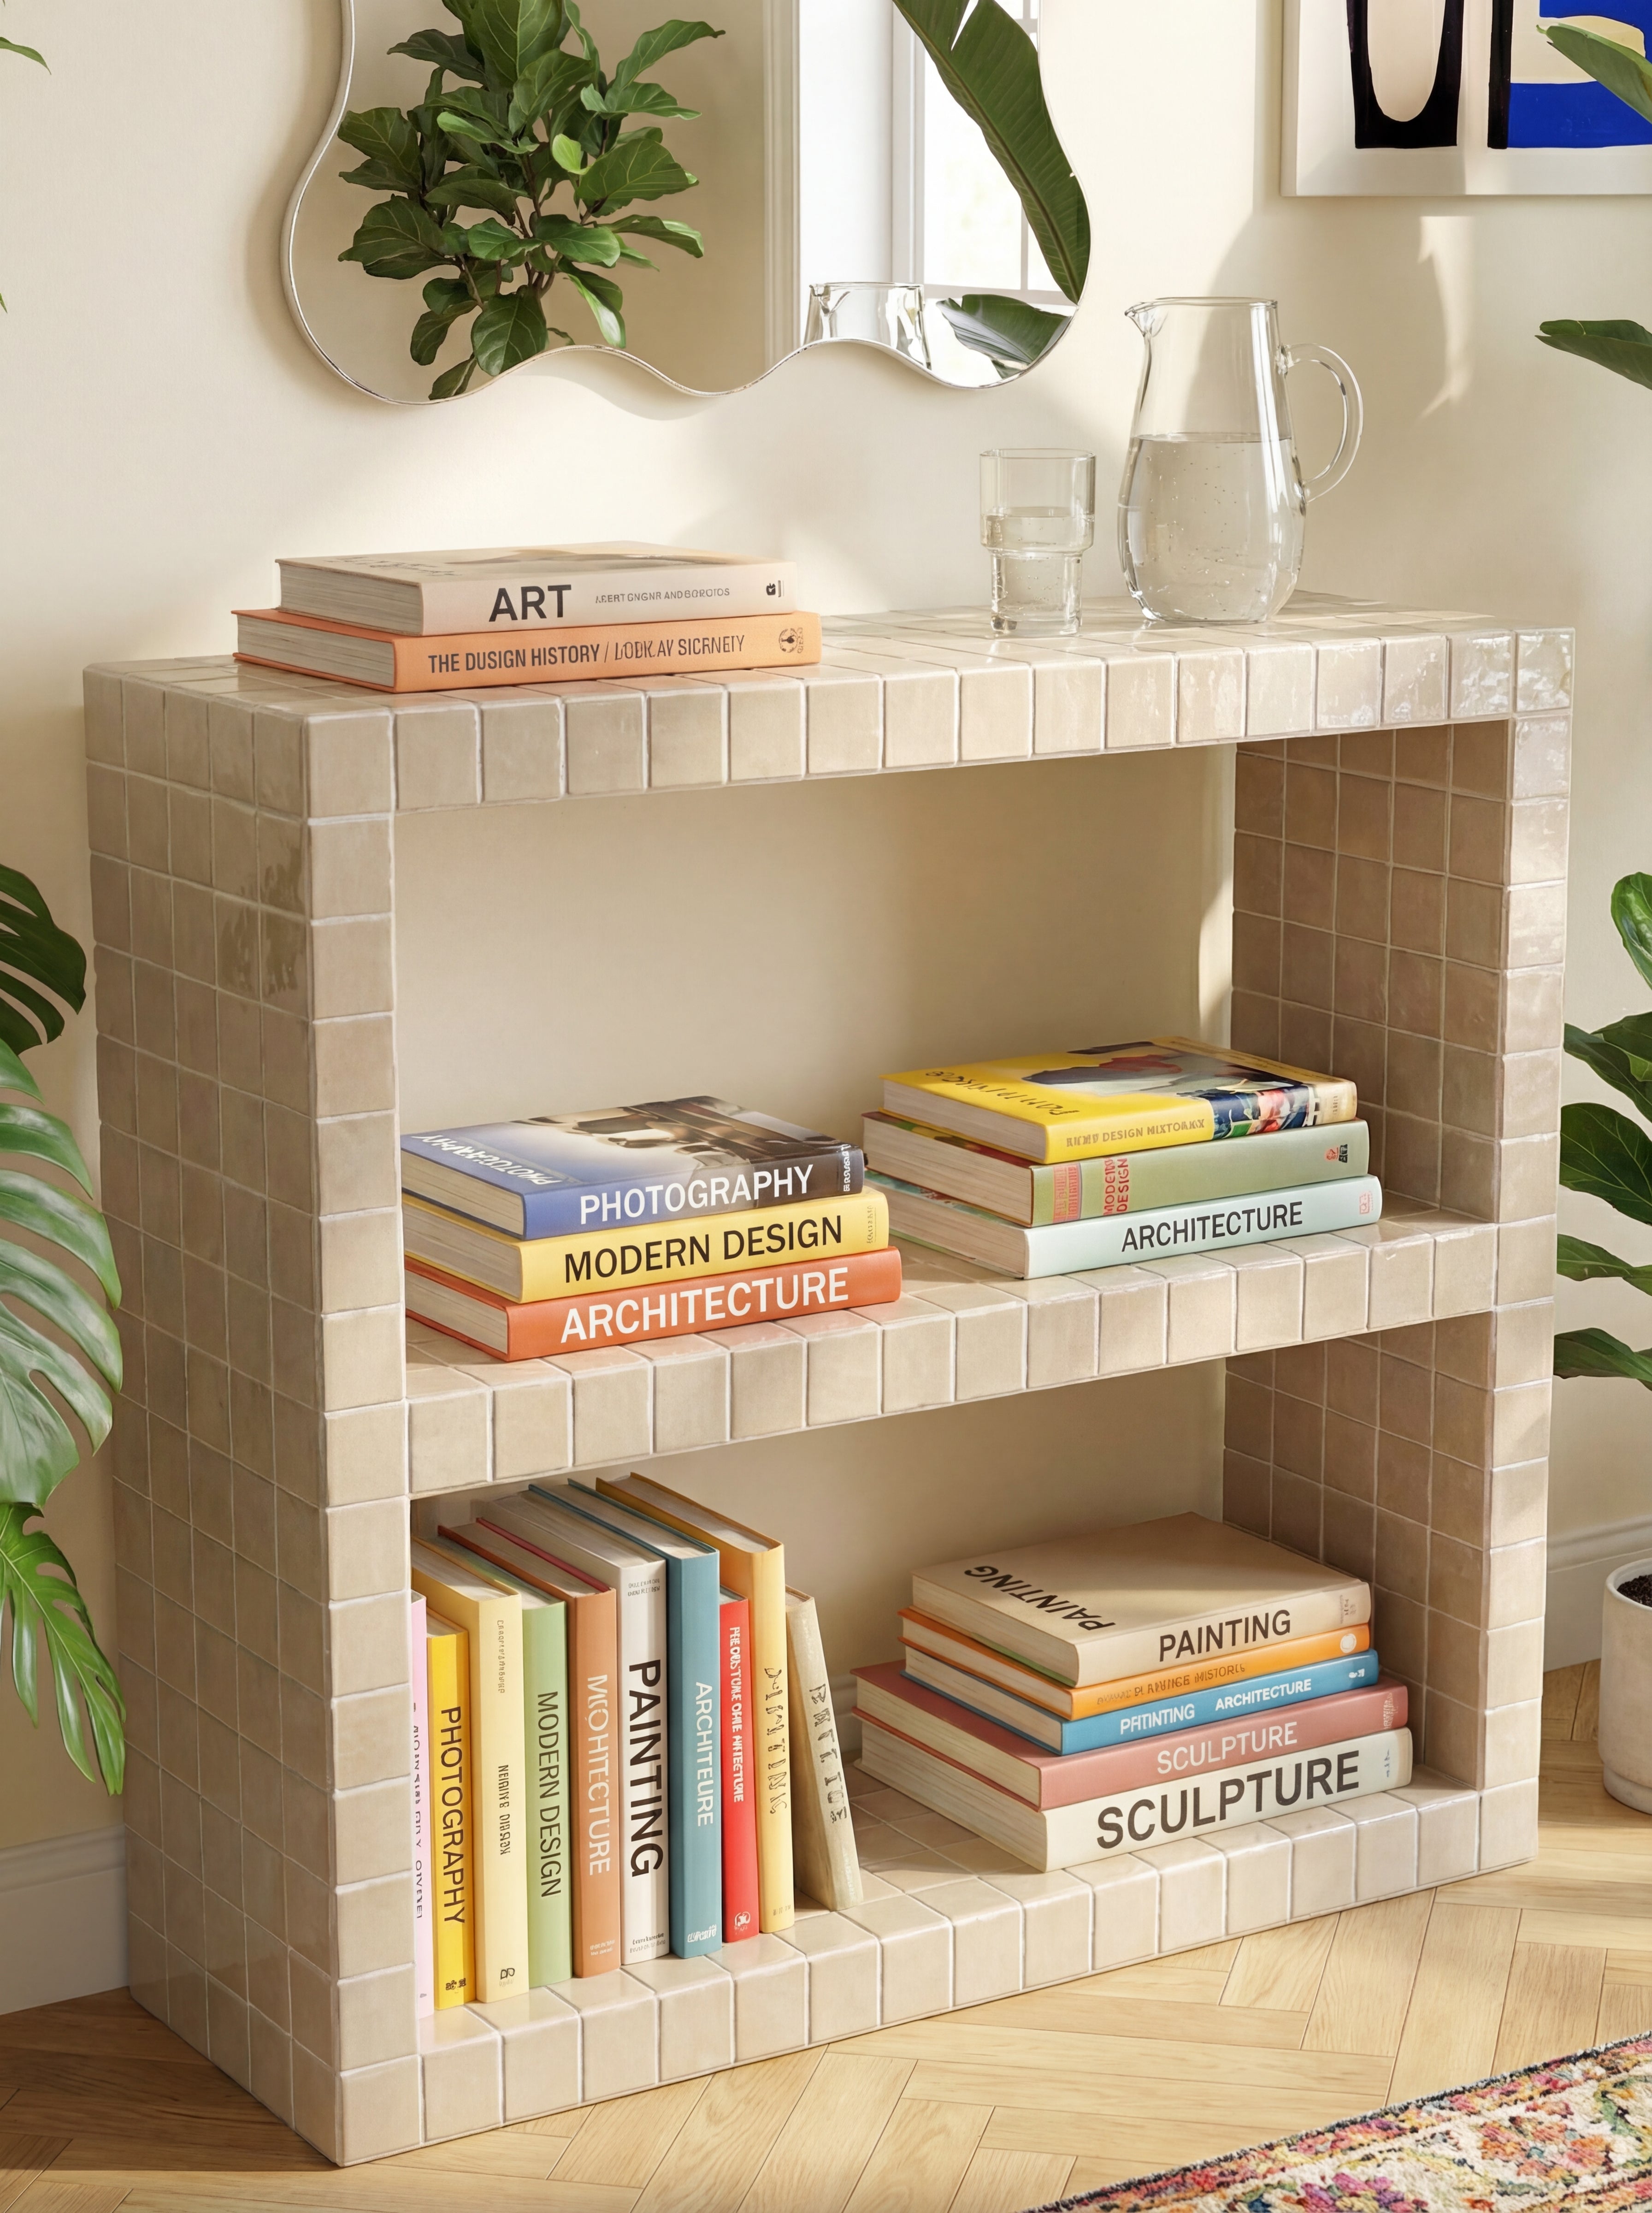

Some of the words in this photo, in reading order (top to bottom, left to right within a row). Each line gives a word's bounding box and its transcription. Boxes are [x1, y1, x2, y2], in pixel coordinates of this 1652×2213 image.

[489, 584, 572, 622] ART
[664, 591, 683, 599] AND
[428, 653, 460, 673] THE
[465, 649, 526, 671] DUSIGN
[531, 644, 600, 667] HISTORY
[1103, 1127, 1143, 1142] DESIGN
[580, 1164, 814, 1225] PHOTOGRAPHY
[565, 1235, 710, 1283] MODERN
[723, 1215, 842, 1260] DESIGN
[1121, 1201, 1303, 1252] ARCHITECTURE
[560, 1266, 849, 1343] ARCHITECTURE
[964, 1566, 1116, 1631] PAINTING
[1159, 1609, 1291, 1663] PAINTING
[1215, 1678, 1312, 1711] ARCHITECTURE
[537, 1691, 560, 1799] MODERN
[629, 1659, 663, 1877] PAINTING
[696, 1682, 714, 1827] ARCHITEURE
[1156, 1721, 1298, 1775] SCULPTURE
[440, 1706, 465, 1923] PHOTOGRAPHY
[1097, 1750, 1359, 1849] SCULPTURE
[540, 1805, 561, 1898] DESIGN
